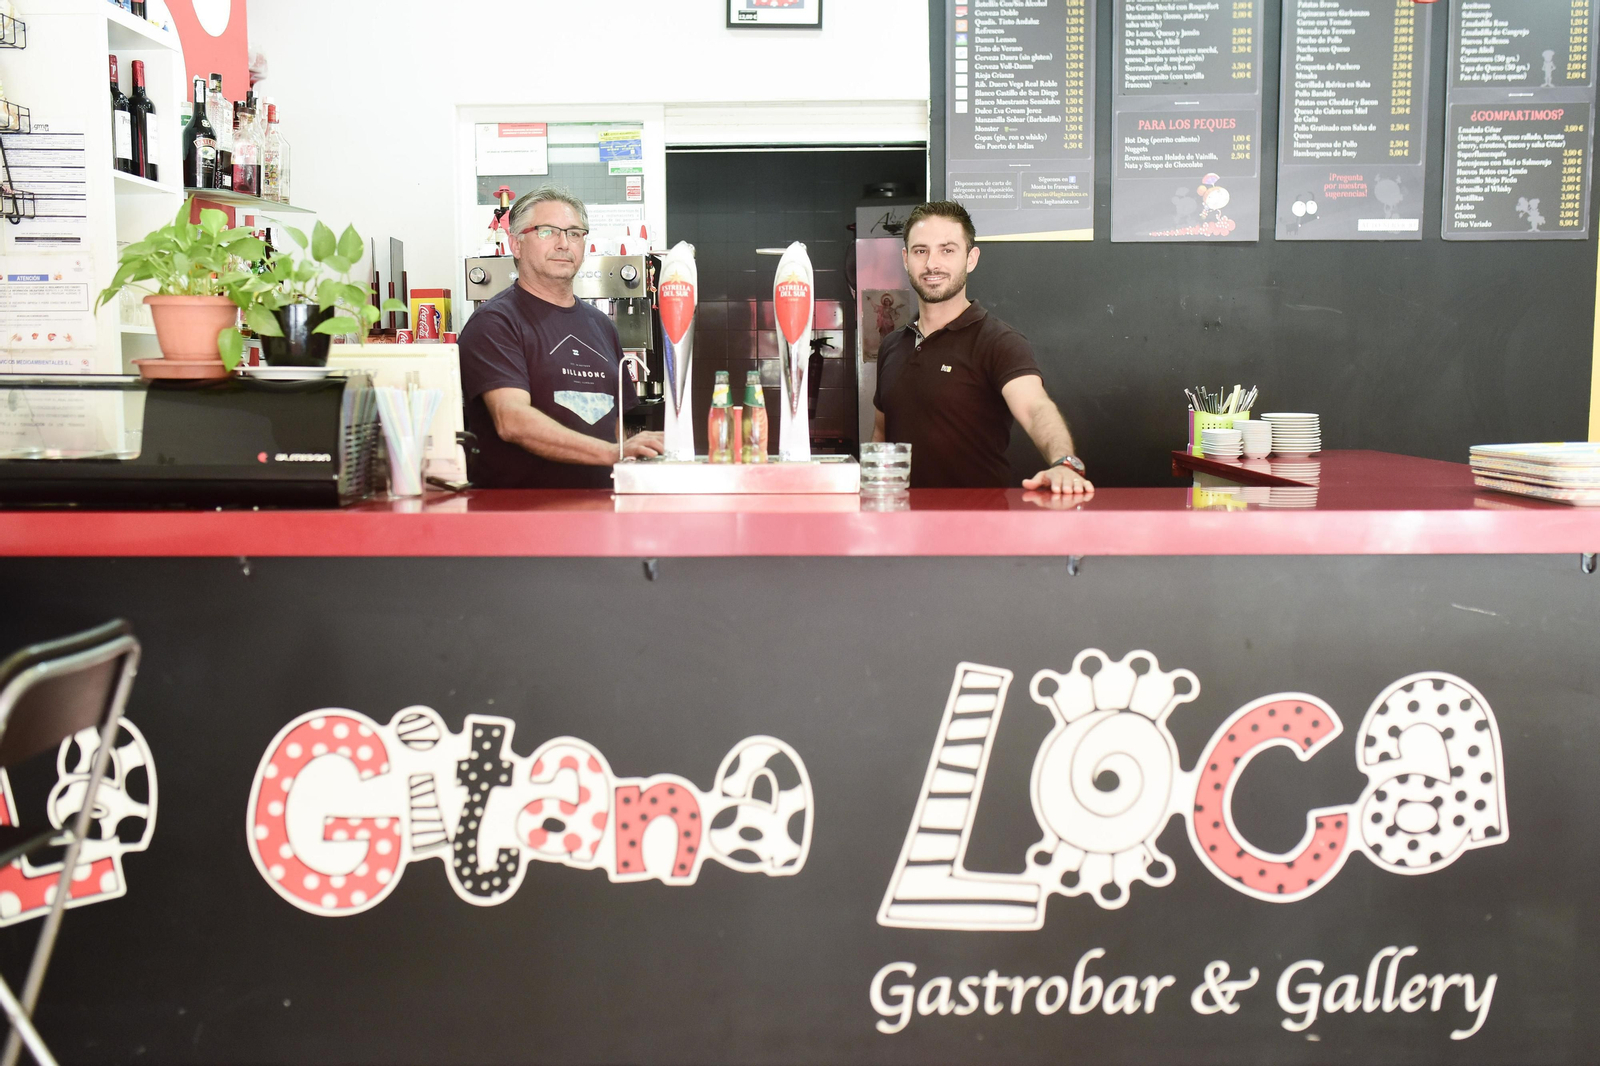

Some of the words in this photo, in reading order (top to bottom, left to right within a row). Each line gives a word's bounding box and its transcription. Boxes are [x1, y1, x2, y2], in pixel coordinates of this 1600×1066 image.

[1471, 110, 1564, 121] ¿COMPARTIMOS?
[1139, 120, 1166, 130] PARA
[1170, 119, 1190, 129] LOS
[1194, 118, 1236, 132] PEQUES
[562, 368, 606, 378] BILLABONG
[247, 705, 814, 917] Gitana
[877, 647, 1509, 932] Loca
[869, 946, 1177, 1035] Gastrobar
[1190, 959, 1260, 1016] &
[1276, 944, 1499, 1041] Gallery
